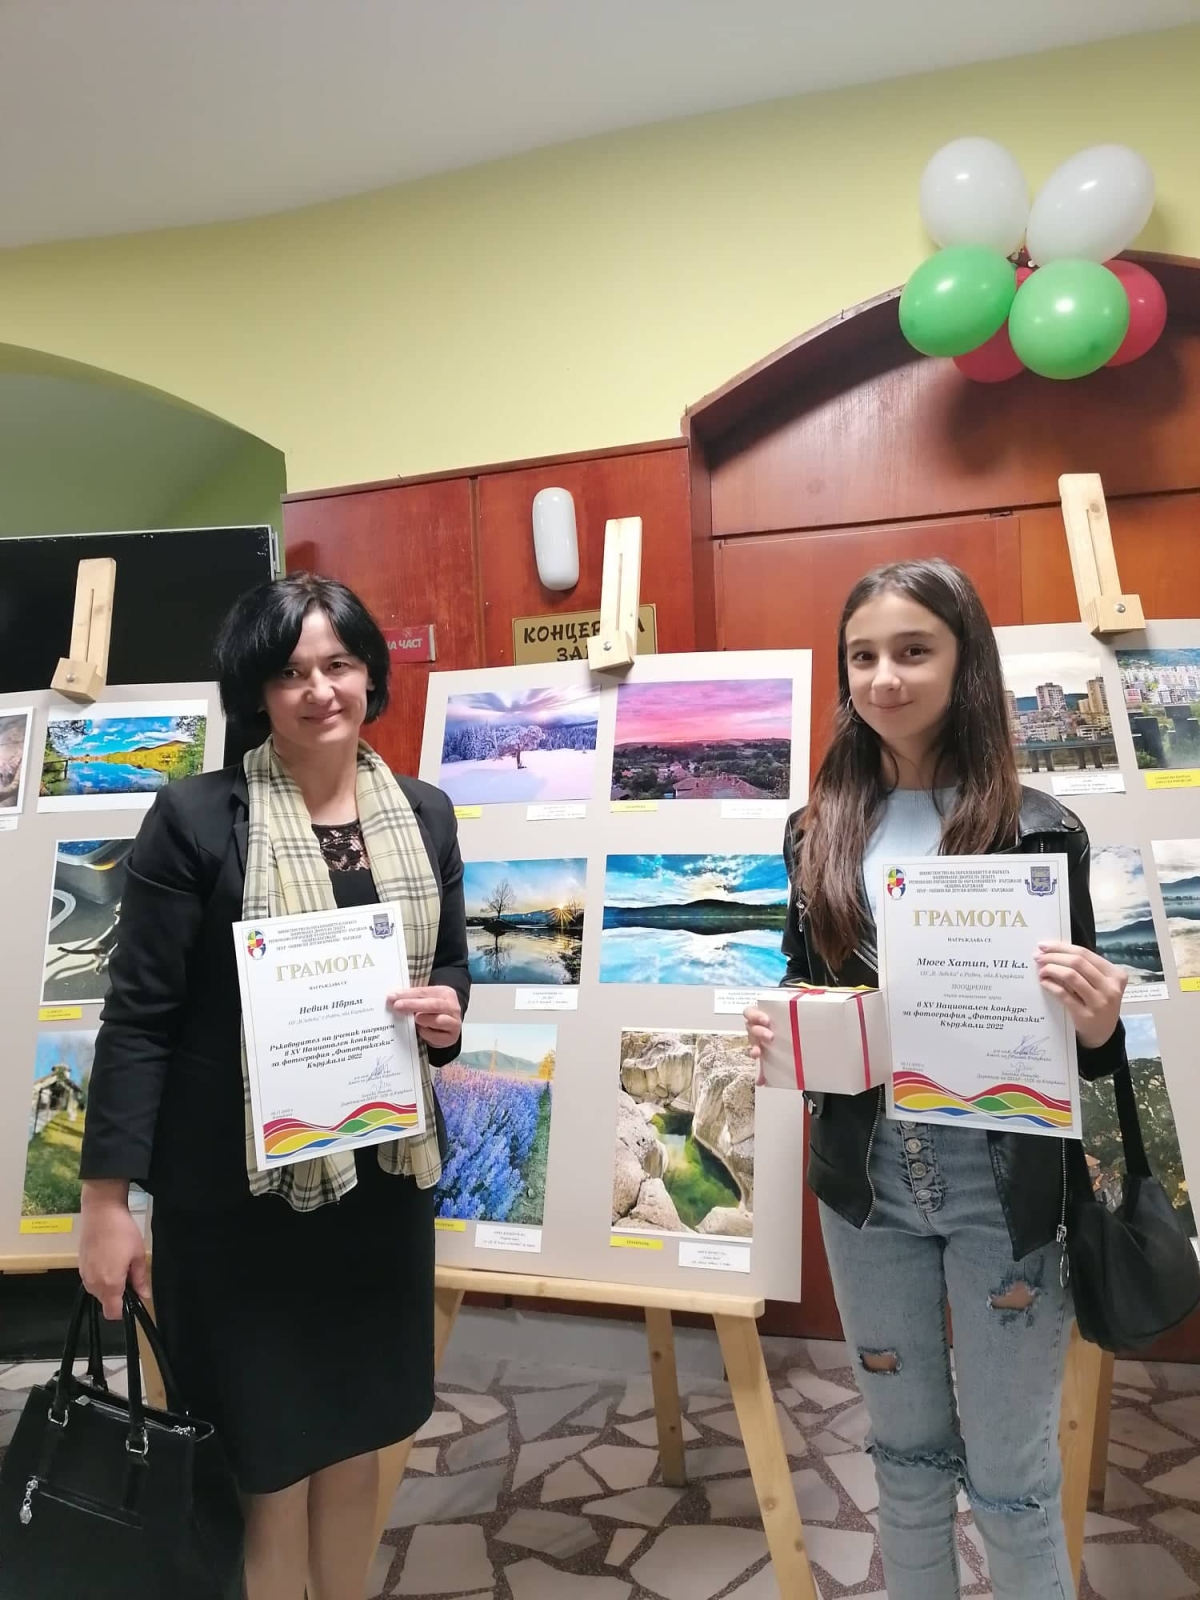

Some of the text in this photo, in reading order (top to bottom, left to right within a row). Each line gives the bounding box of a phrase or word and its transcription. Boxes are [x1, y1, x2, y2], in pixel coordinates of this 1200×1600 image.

[398, 638, 422, 649] ЧАСТ
[913, 909, 1028, 927] ГРАМОТА
[275, 952, 376, 982] ГРАМОТА
[916, 958, 1028, 969] Мюге Хатип, VII кл.
[299, 998, 364, 1015] Невин Ибрям
[935, 1002, 989, 1012] Национален
[990, 1004, 1027, 1014] конкурс
[913, 1010, 966, 1020] фотография
[940, 1020, 984, 1030] Кърджали
[269, 1039, 320, 1052] Ръководител
[332, 1030, 361, 1041] ученик
[302, 1040, 349, 1054] Национален
[350, 1034, 380, 1045] конкурс
[281, 1051, 330, 1066] фотография
[306, 1056, 346, 1068] Кърджали
